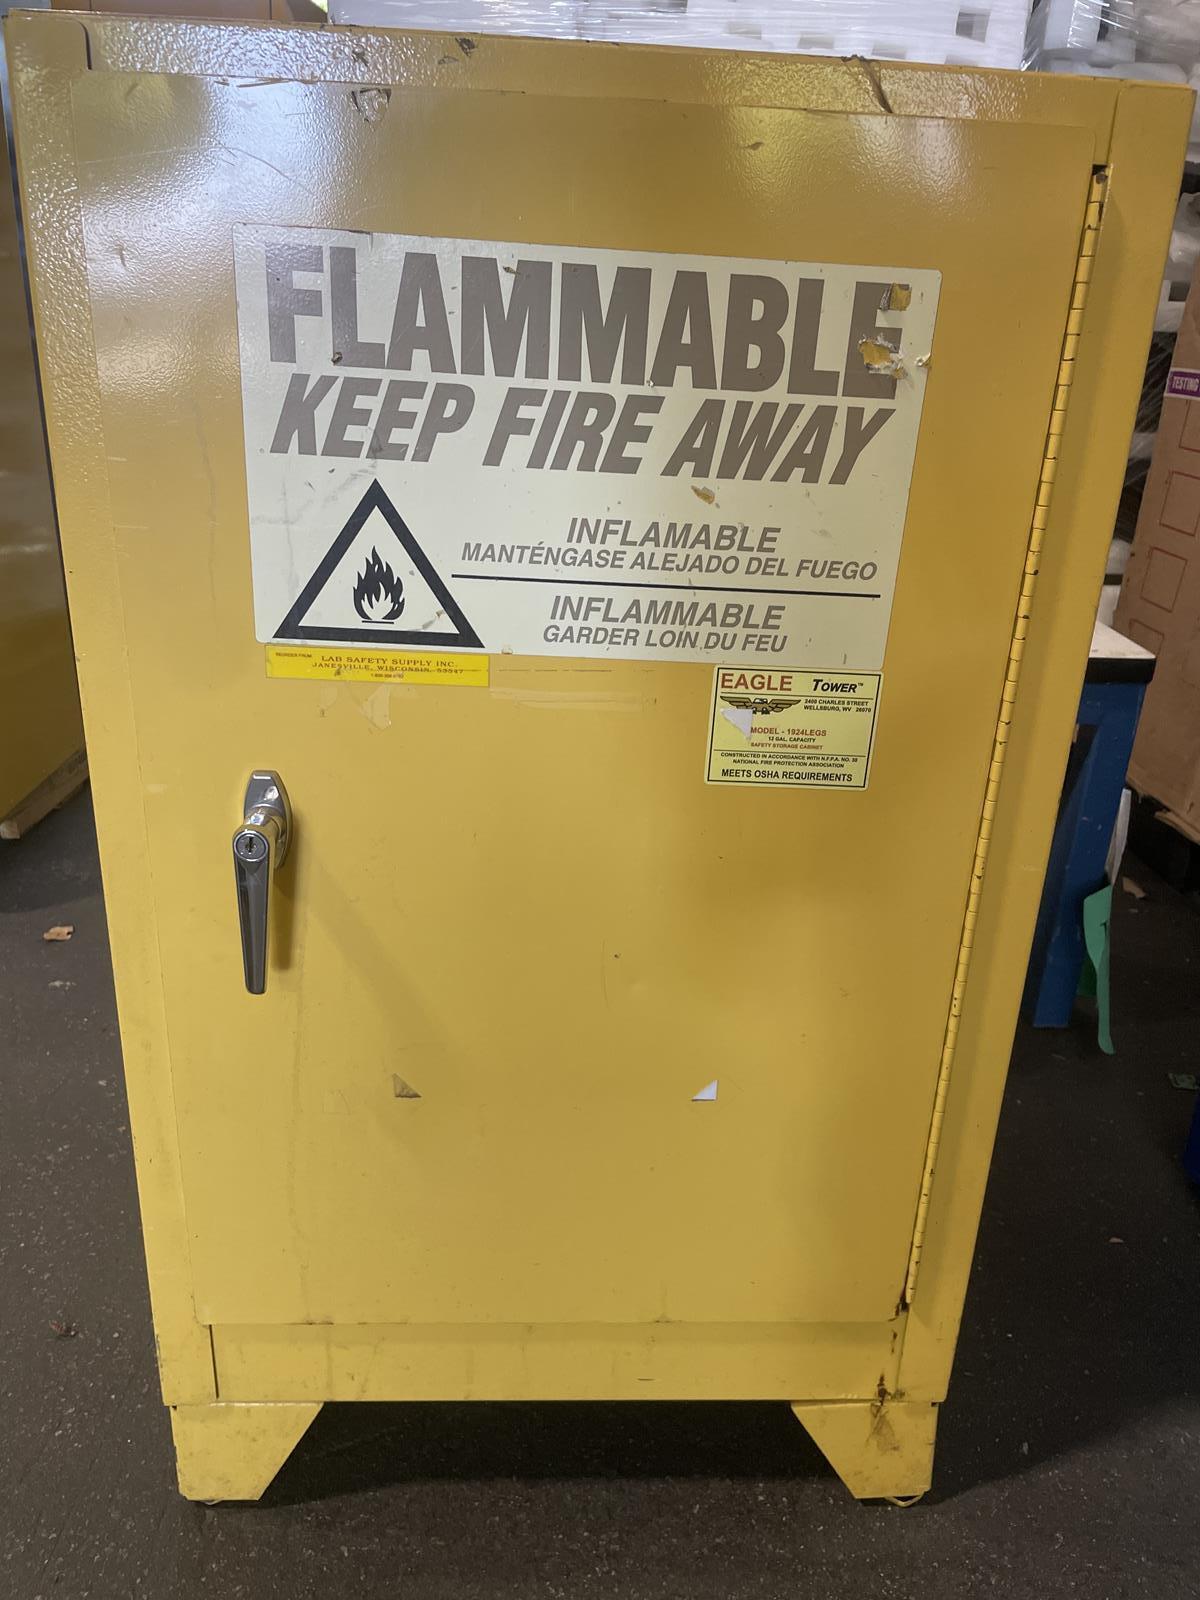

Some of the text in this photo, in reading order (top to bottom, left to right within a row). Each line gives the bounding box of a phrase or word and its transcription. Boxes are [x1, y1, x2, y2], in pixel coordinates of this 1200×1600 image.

[264, 244, 912, 400] FLAMMABLE
[269, 372, 897, 486] KEEP FIRE AWAY
[566, 517, 781, 554] INFLAMABLE
[461, 541, 878, 581] MANTÉNGASE ALEJADO DEL FUEGO
[549, 595, 787, 631] INFLAMMABLE
[542, 624, 789, 653] GARDER LOIN DU FEU
[321, 655, 343, 663] LAB
[346, 656, 388, 665] SAFETY
[391, 658, 432, 667] SUPPLY
[720, 672, 793, 692] EAGLE
[750, 726, 780, 736] MODEL
[787, 729, 827, 737] 1924LEGS
[721, 768, 853, 782] MEETS OSHA REQUIREMENTS
